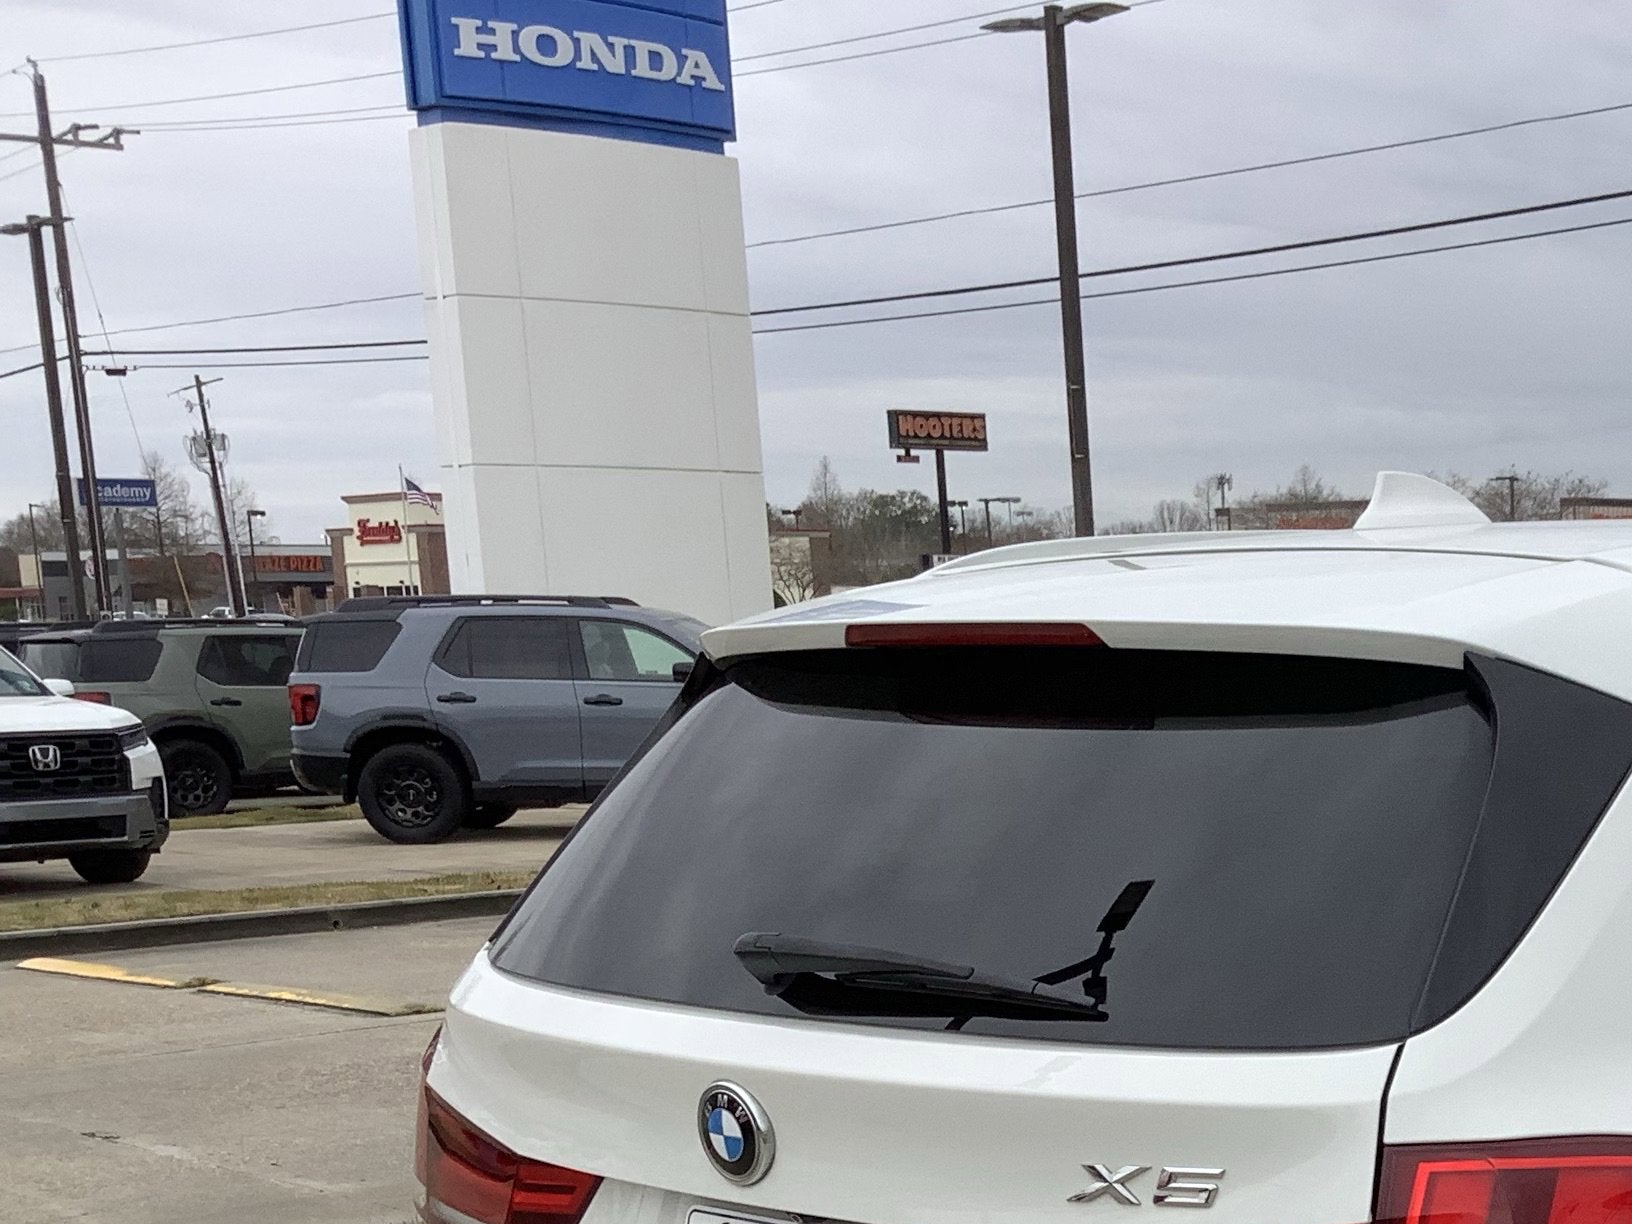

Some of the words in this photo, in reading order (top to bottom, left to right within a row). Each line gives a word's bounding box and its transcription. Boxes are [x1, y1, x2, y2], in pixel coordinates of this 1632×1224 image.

[450, 16, 726, 91] HONDA
[898, 415, 985, 438] HOOTERS
[97, 483, 153, 502] cademy
[289, 555, 325, 572] PIZZA
[704, 1093, 750, 1125] BMW
[1065, 1163, 1227, 1210] X5
